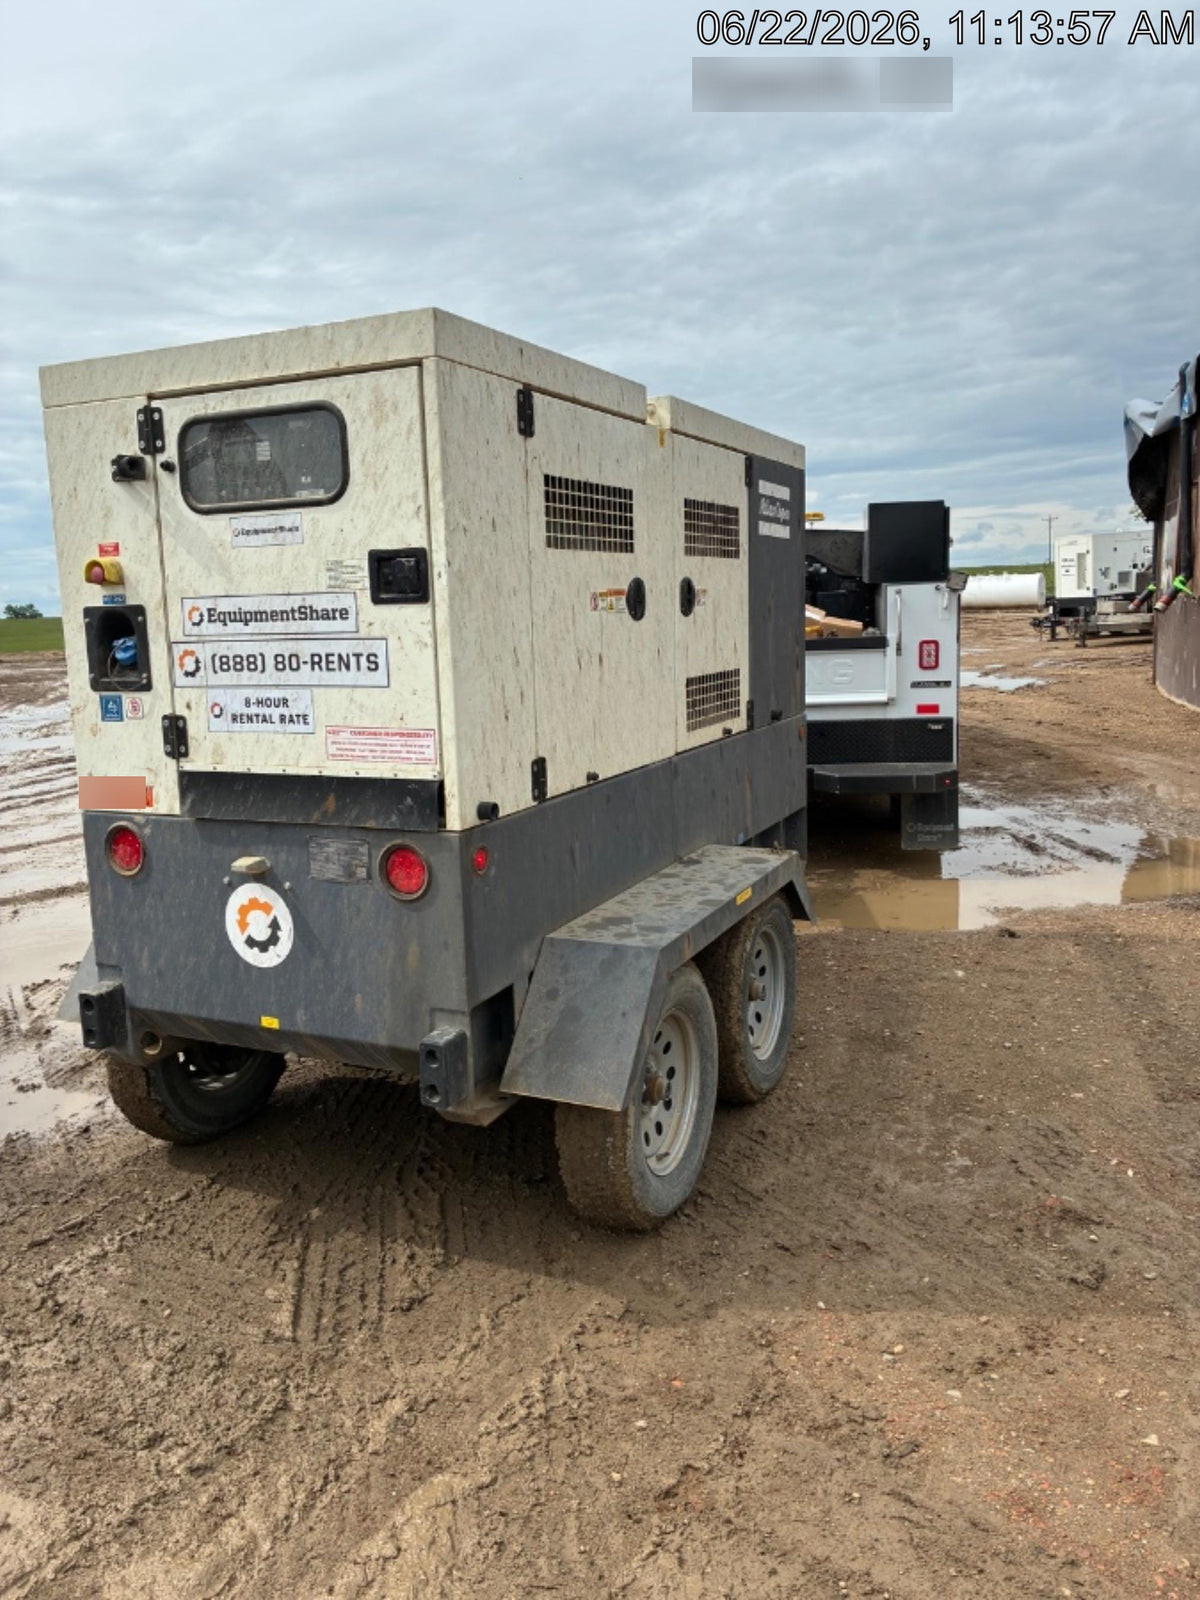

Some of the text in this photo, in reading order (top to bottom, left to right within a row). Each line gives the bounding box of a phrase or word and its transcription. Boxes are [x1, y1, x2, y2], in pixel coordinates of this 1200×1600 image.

[206, 605, 350, 627] EquipmentShare
[210, 652, 380, 674] (888) 80-RENTS
[244, 697, 290, 709] 8-HOUR
[231, 713, 311, 726] RENTAL RATE
